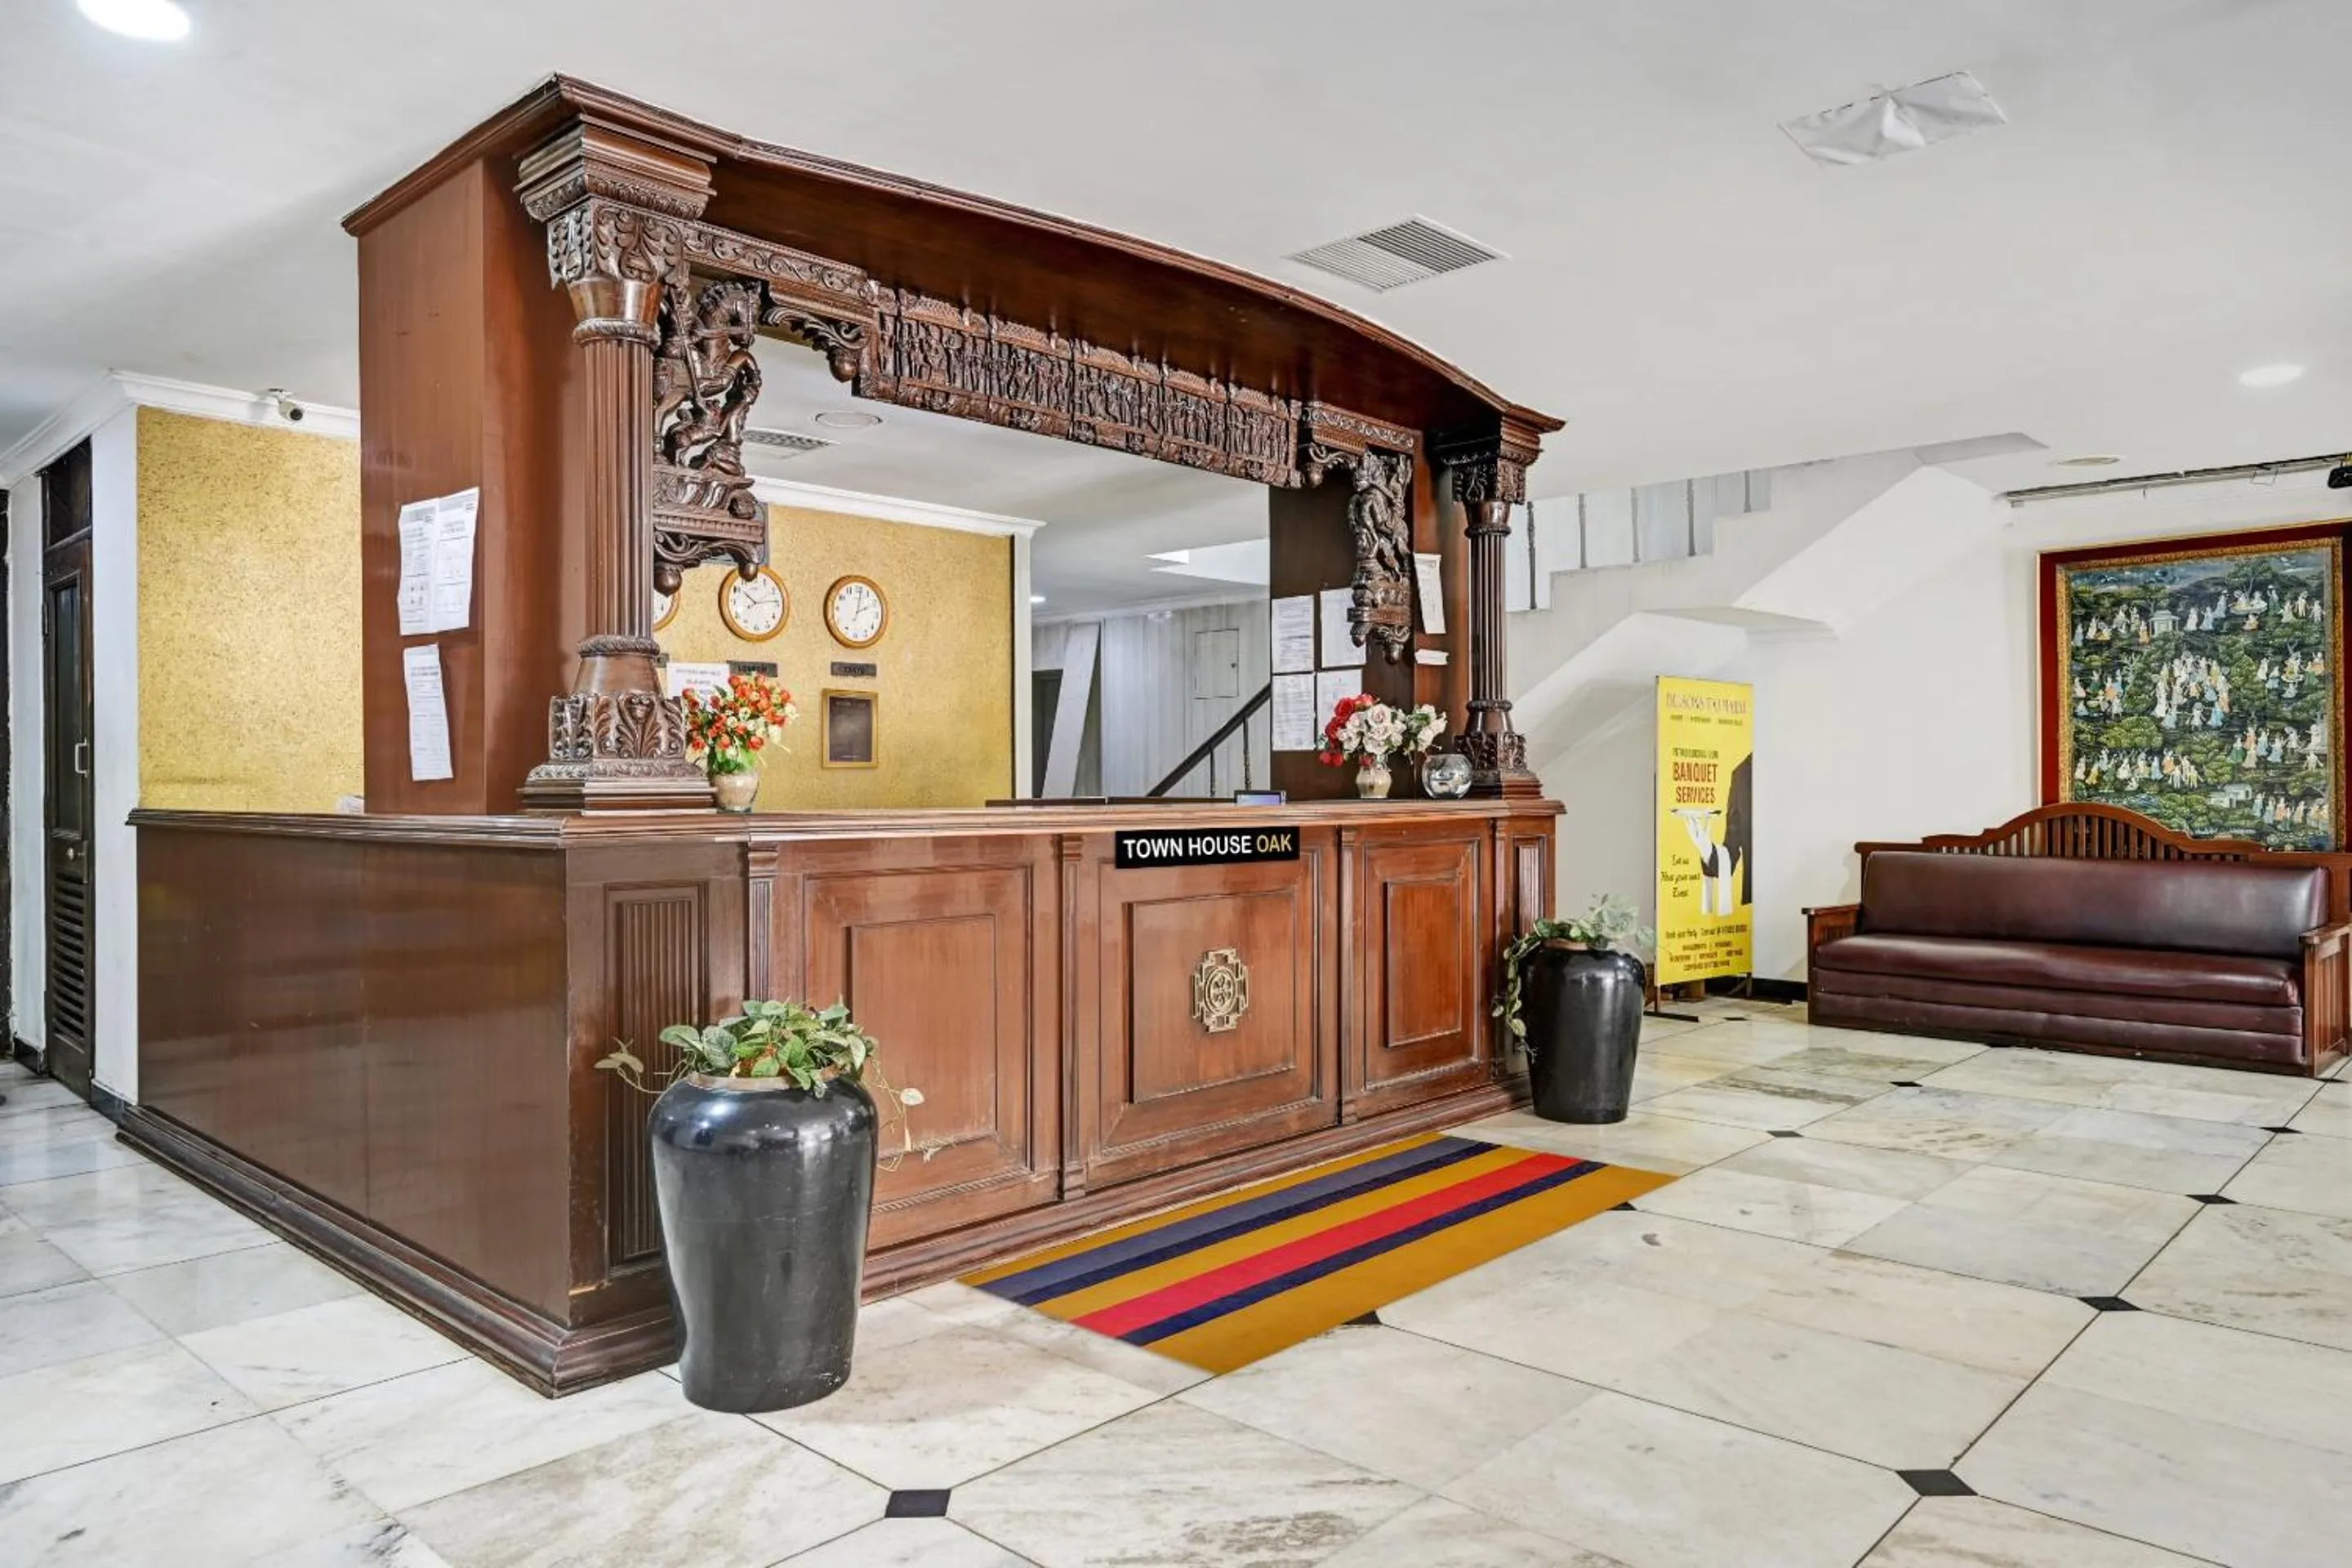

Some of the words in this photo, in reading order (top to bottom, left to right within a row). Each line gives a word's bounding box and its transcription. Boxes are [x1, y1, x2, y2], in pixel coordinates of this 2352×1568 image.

[1673, 761, 1718, 782] BANQUET
[1676, 786, 1717, 804] SERVICES
[1122, 837, 1184, 859] TOWN
[1187, 835, 1253, 857] HOUSE
[1256, 833, 1293, 853] OAK
